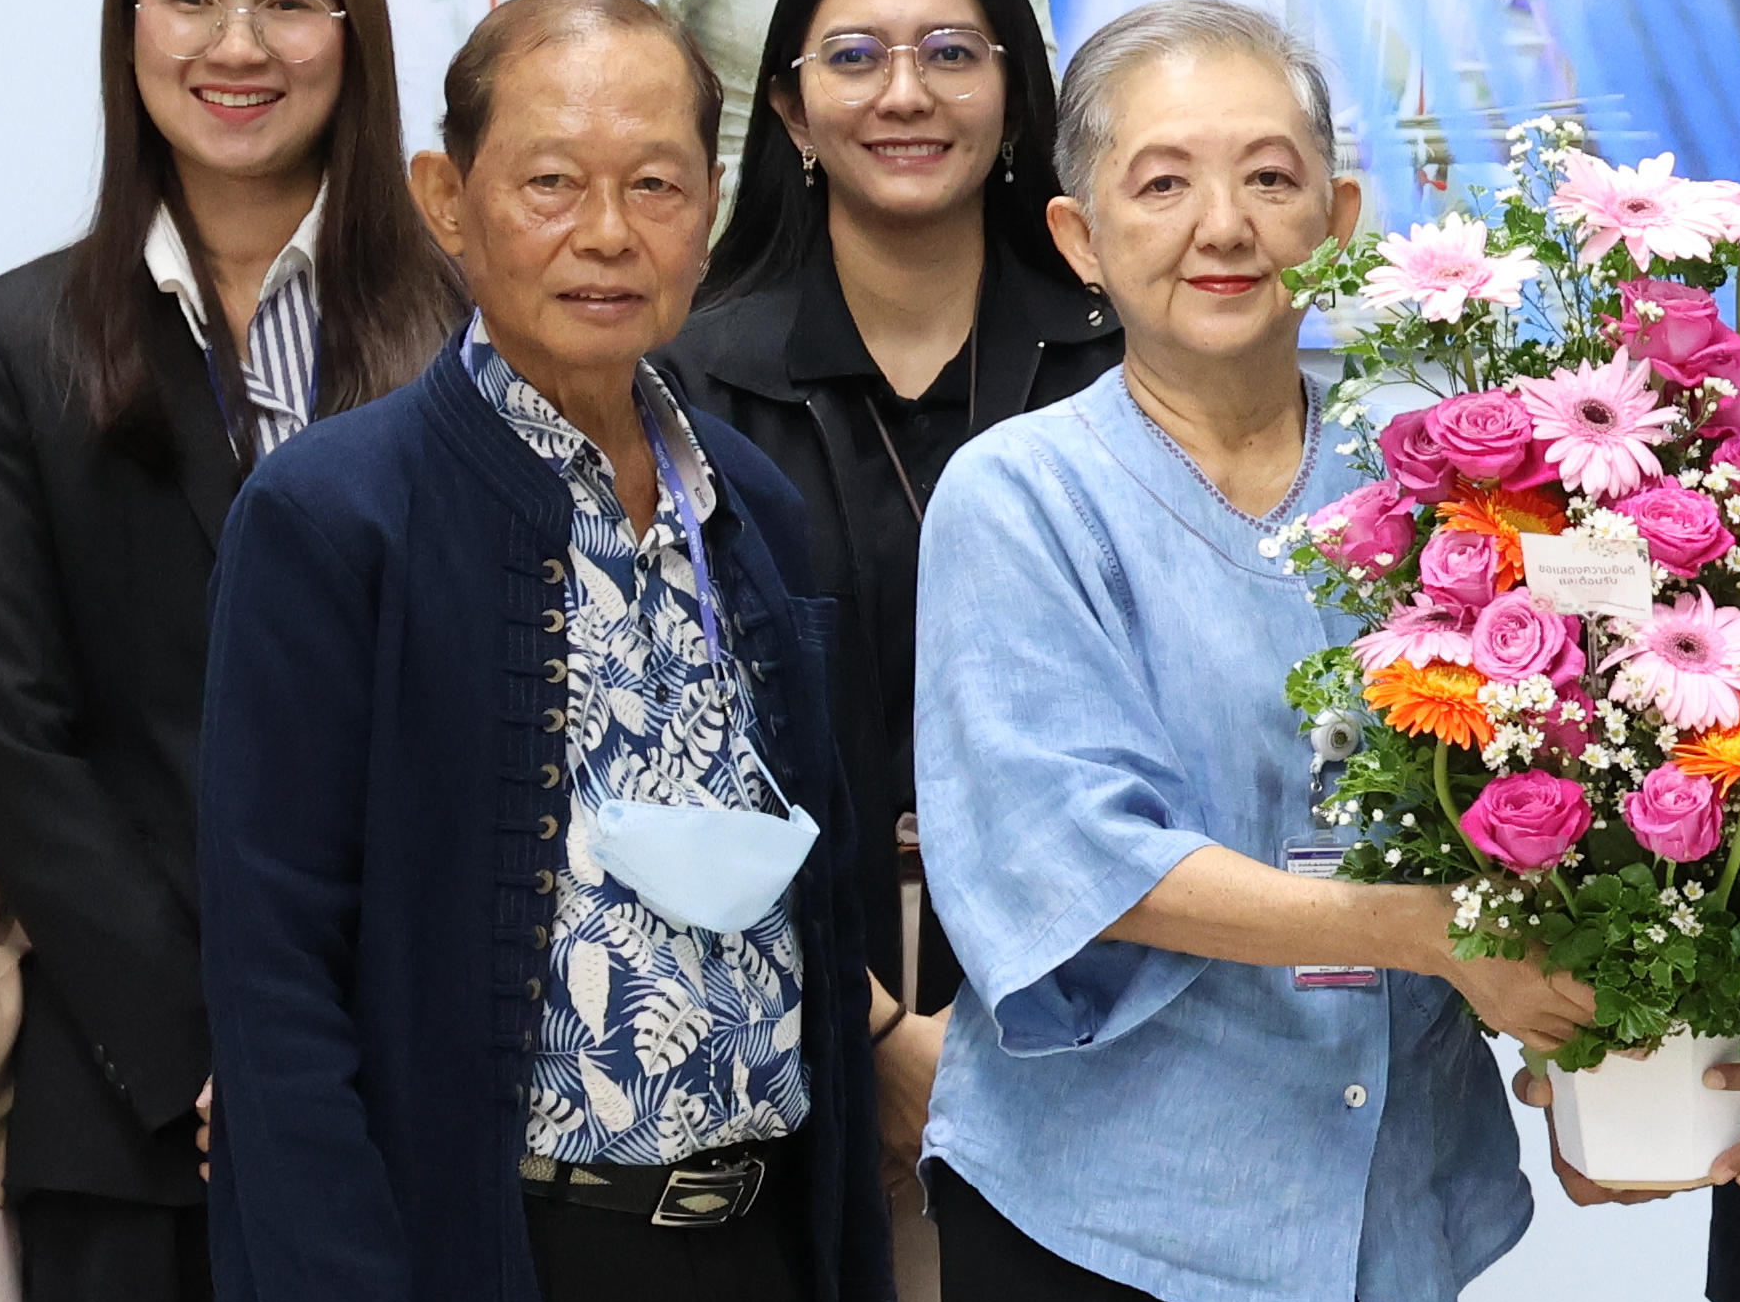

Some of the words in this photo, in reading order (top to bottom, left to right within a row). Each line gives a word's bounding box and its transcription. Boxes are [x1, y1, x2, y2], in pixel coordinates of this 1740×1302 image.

[1538, 563, 1636, 576] ขอแสดงความยินดี
